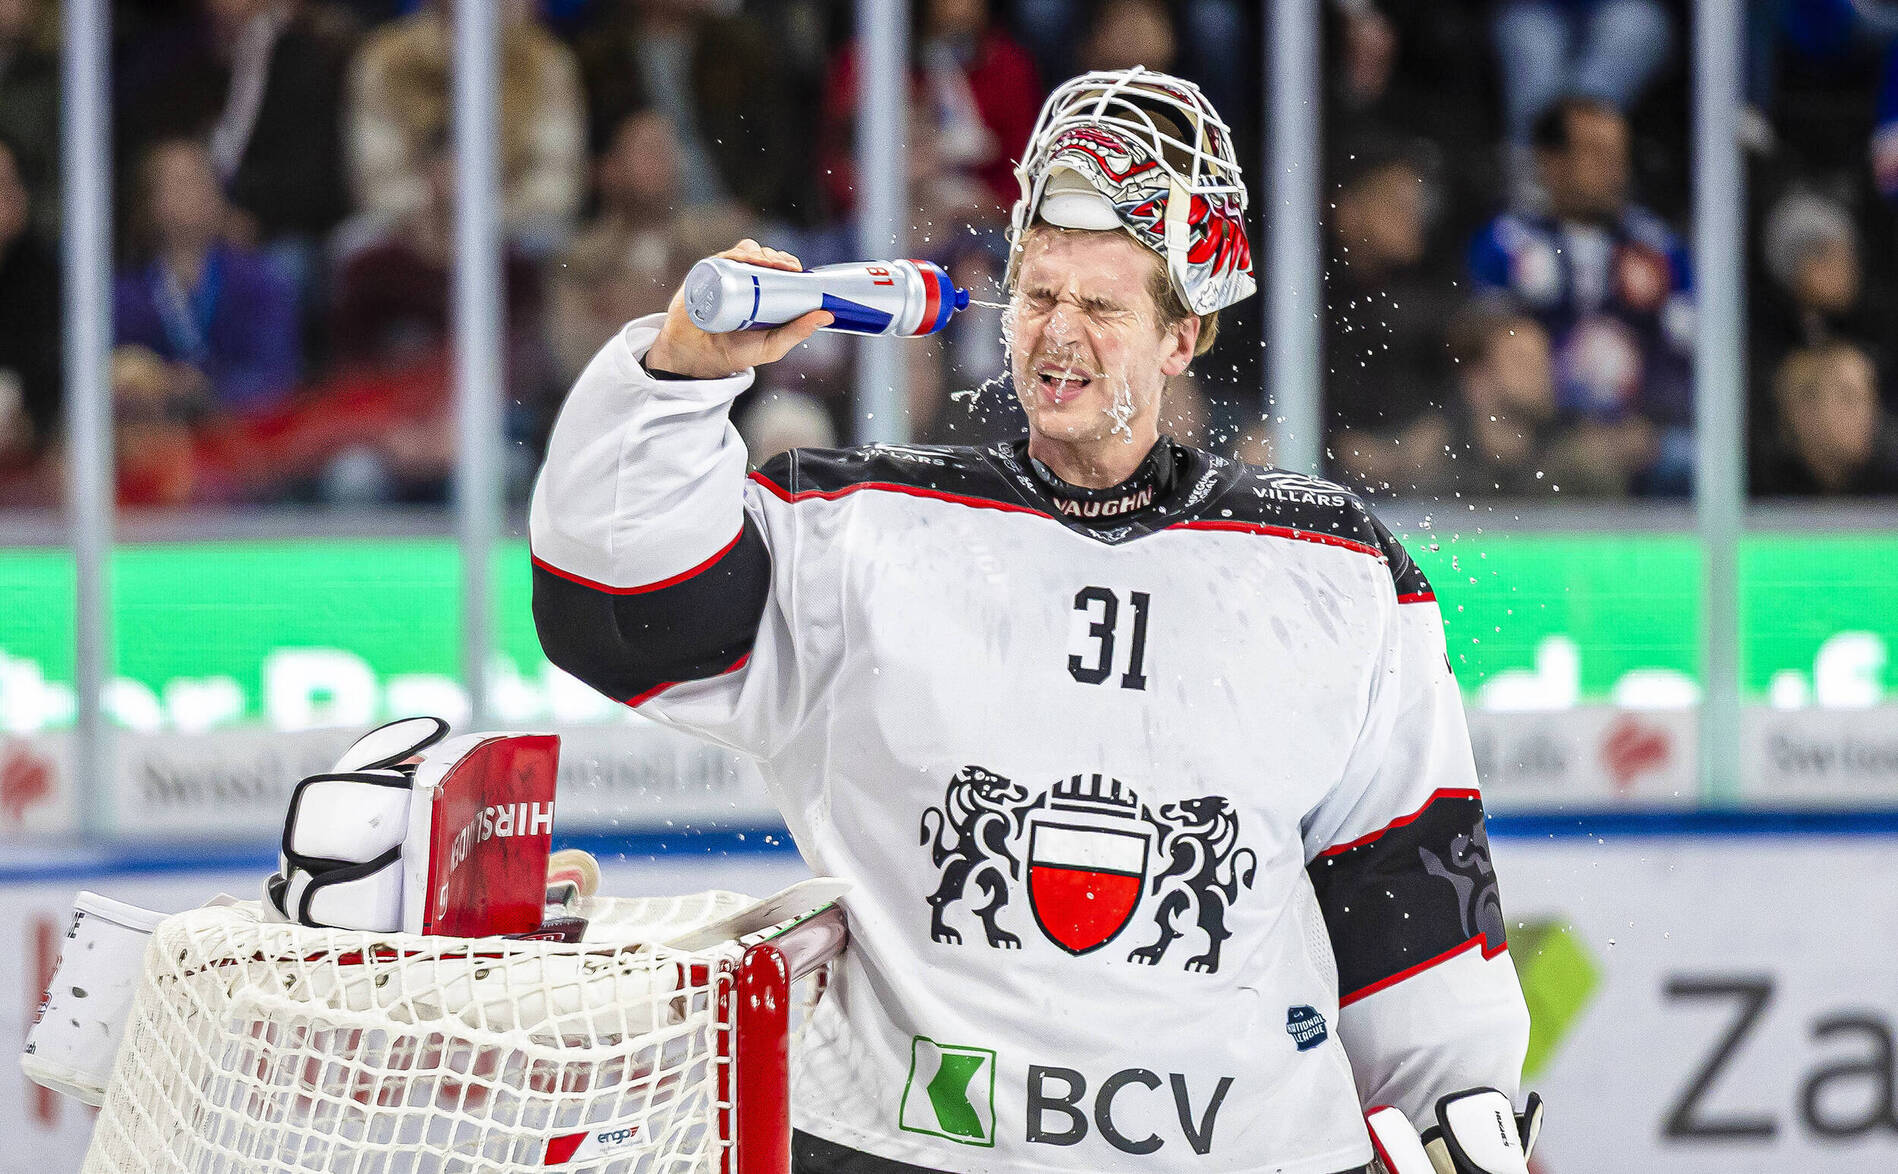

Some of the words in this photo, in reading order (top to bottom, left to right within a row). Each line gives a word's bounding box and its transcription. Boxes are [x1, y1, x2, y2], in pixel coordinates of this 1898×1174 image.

[1053, 484, 1153, 518] VAUGHN
[1252, 487, 1346, 507] VILLARS
[1067, 586, 1151, 691] 31
[1286, 1014, 1325, 1033] NATIONAL
[1293, 1023, 1326, 1043] LEAGUE
[1026, 1064, 1236, 1156] BCV
[597, 1128, 631, 1144] engo
